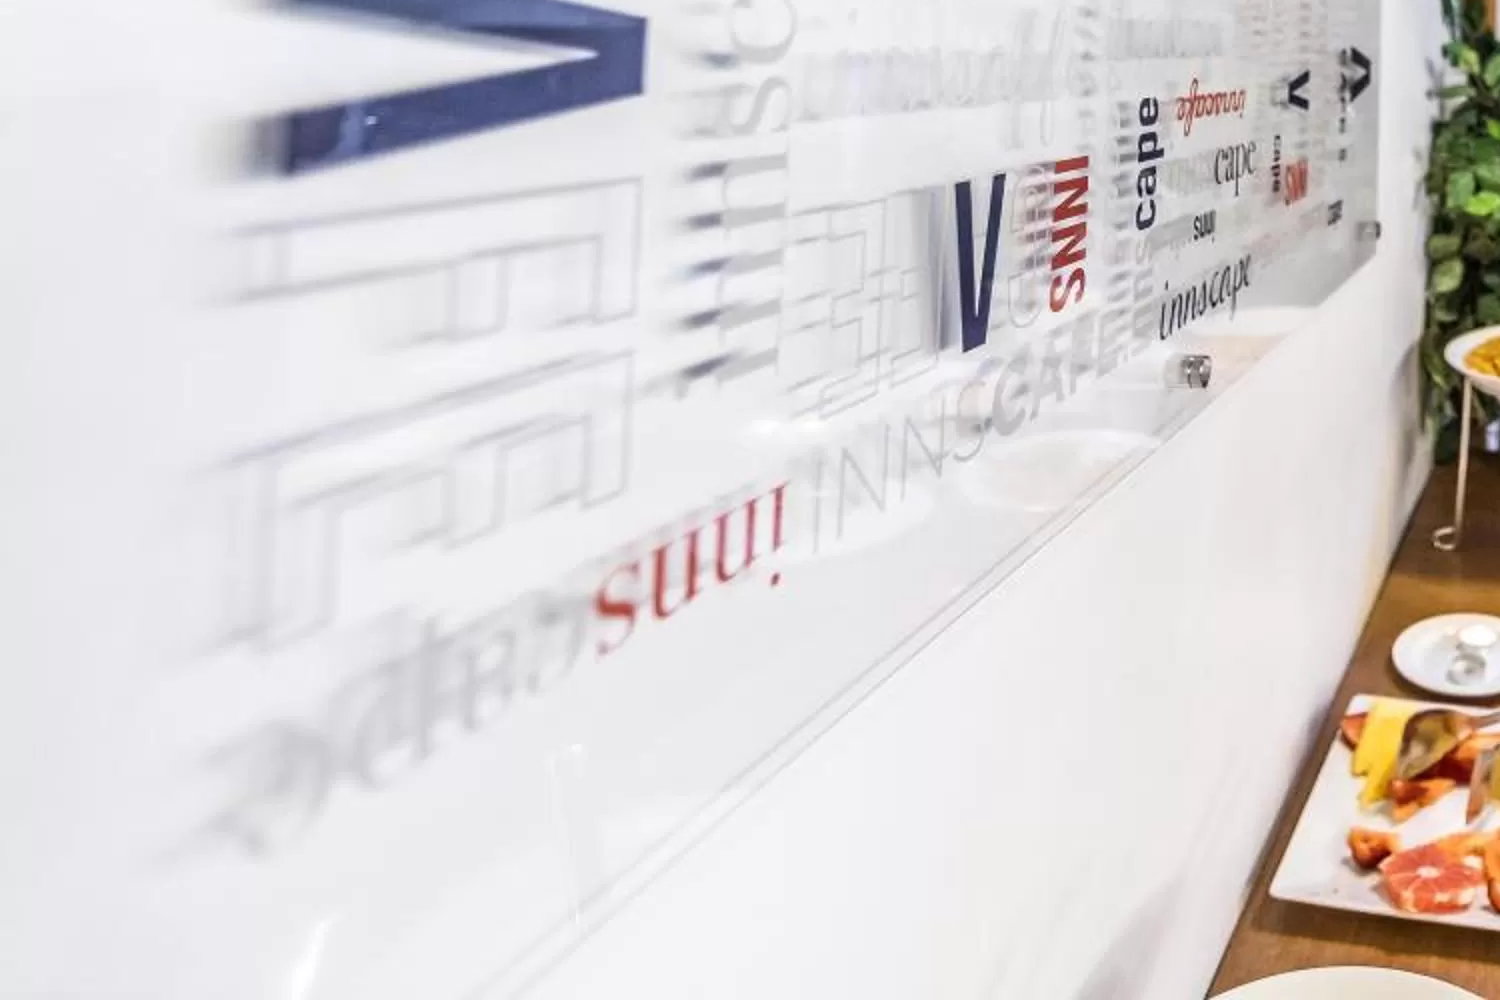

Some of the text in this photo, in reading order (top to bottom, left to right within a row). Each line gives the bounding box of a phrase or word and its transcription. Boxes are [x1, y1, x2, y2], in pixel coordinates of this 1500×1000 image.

[1135, 96, 1166, 231] cape
[1213, 139, 1257, 198] cape
[1048, 154, 1091, 314] INNS
